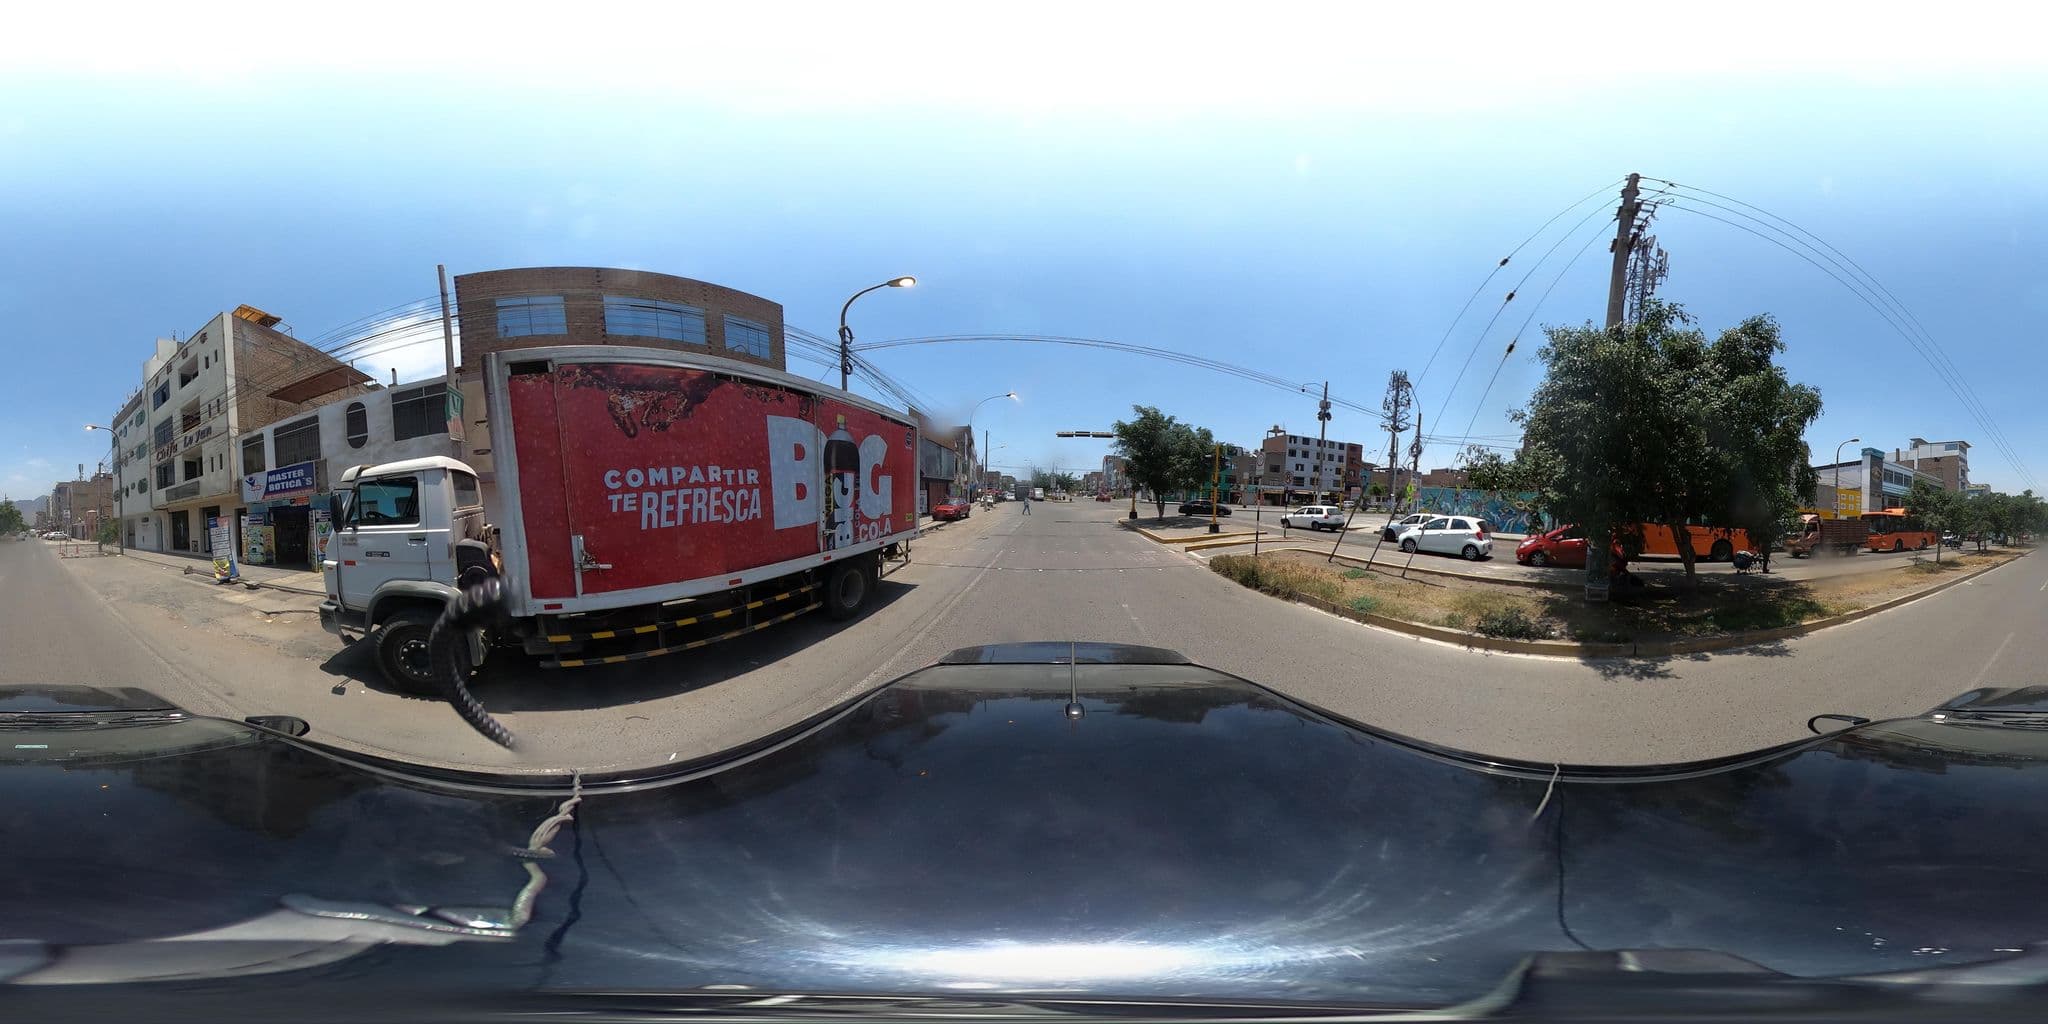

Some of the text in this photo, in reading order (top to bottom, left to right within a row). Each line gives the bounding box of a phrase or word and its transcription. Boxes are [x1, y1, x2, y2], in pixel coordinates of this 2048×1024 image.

[268, 469, 305, 483] MASTER
[604, 465, 760, 490] COMPARTIR
[607, 486, 762, 530] TE REFRESCA
[859, 518, 892, 541] COLA
